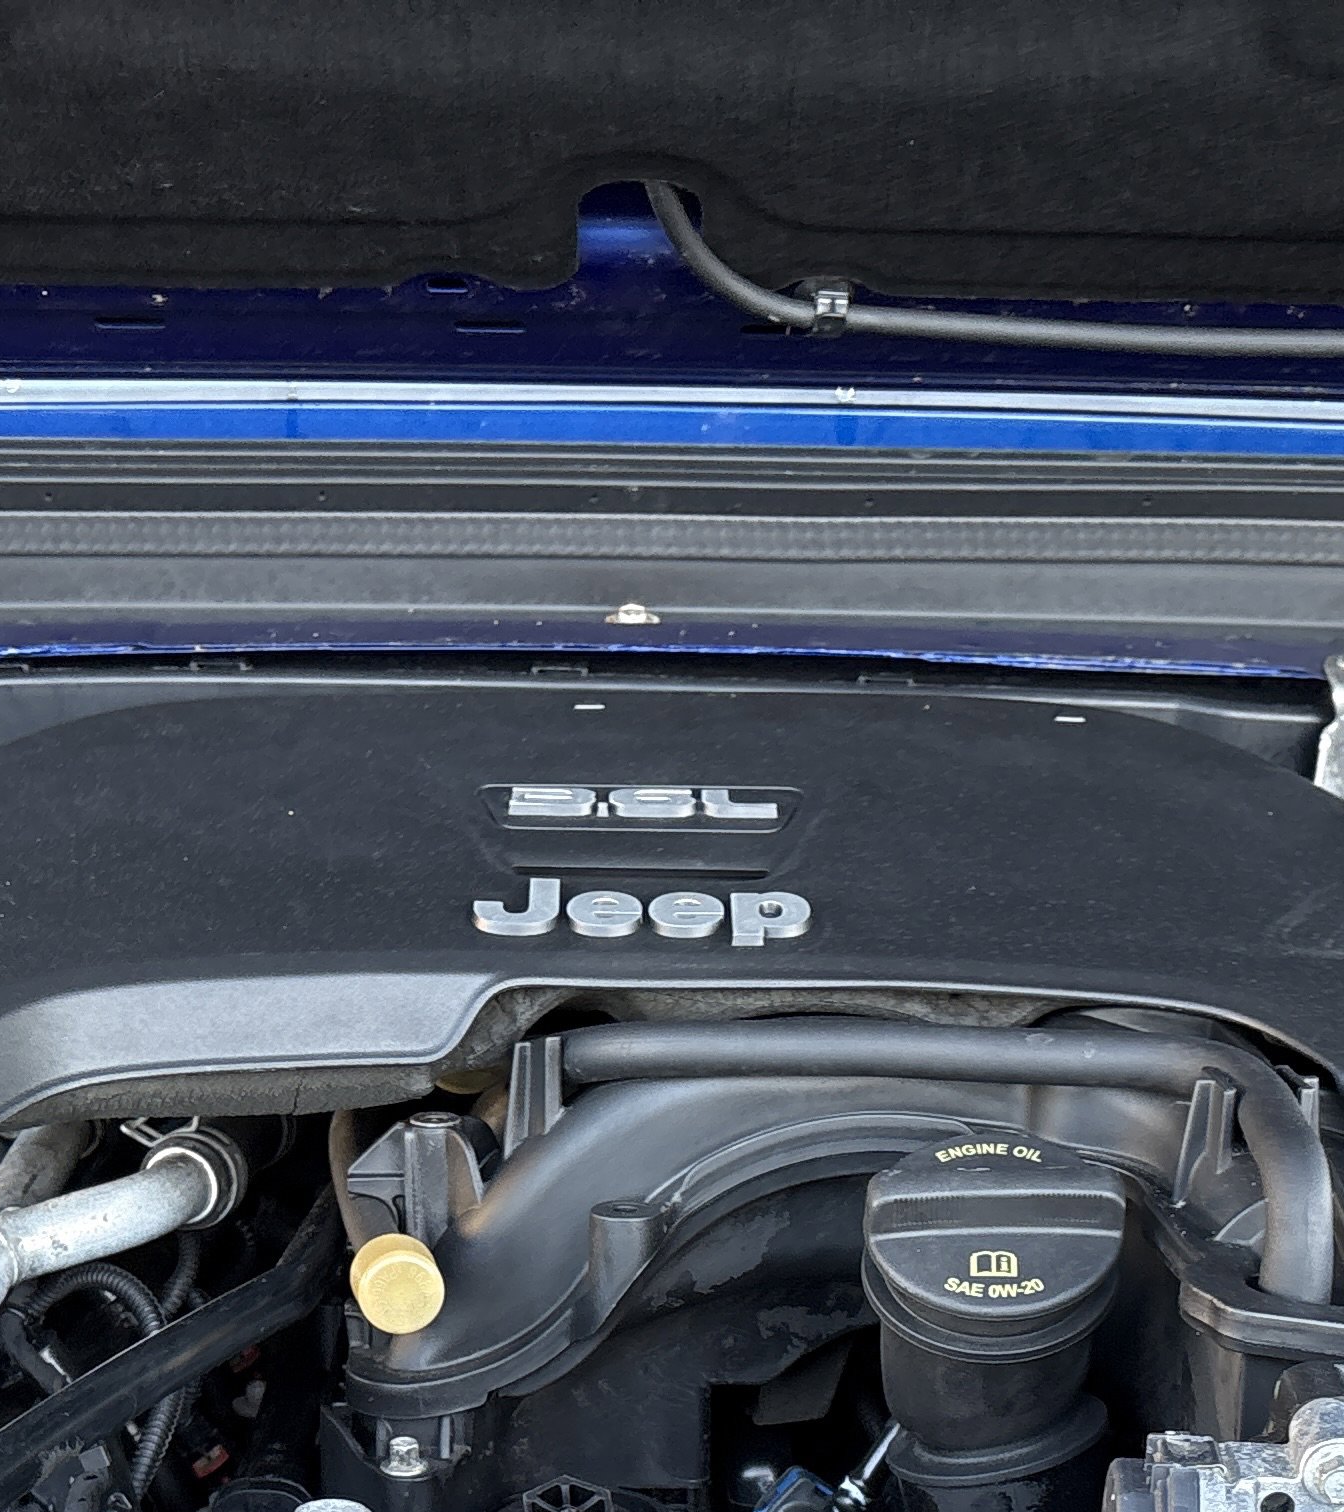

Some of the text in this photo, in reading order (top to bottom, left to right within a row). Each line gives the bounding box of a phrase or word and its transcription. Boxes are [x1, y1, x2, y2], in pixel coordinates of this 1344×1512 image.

[471, 876, 812, 947] Jeep
[934, 1143, 1043, 1164] ENGINE OIL
[944, 1277, 1045, 1299] SAE 0W-20
